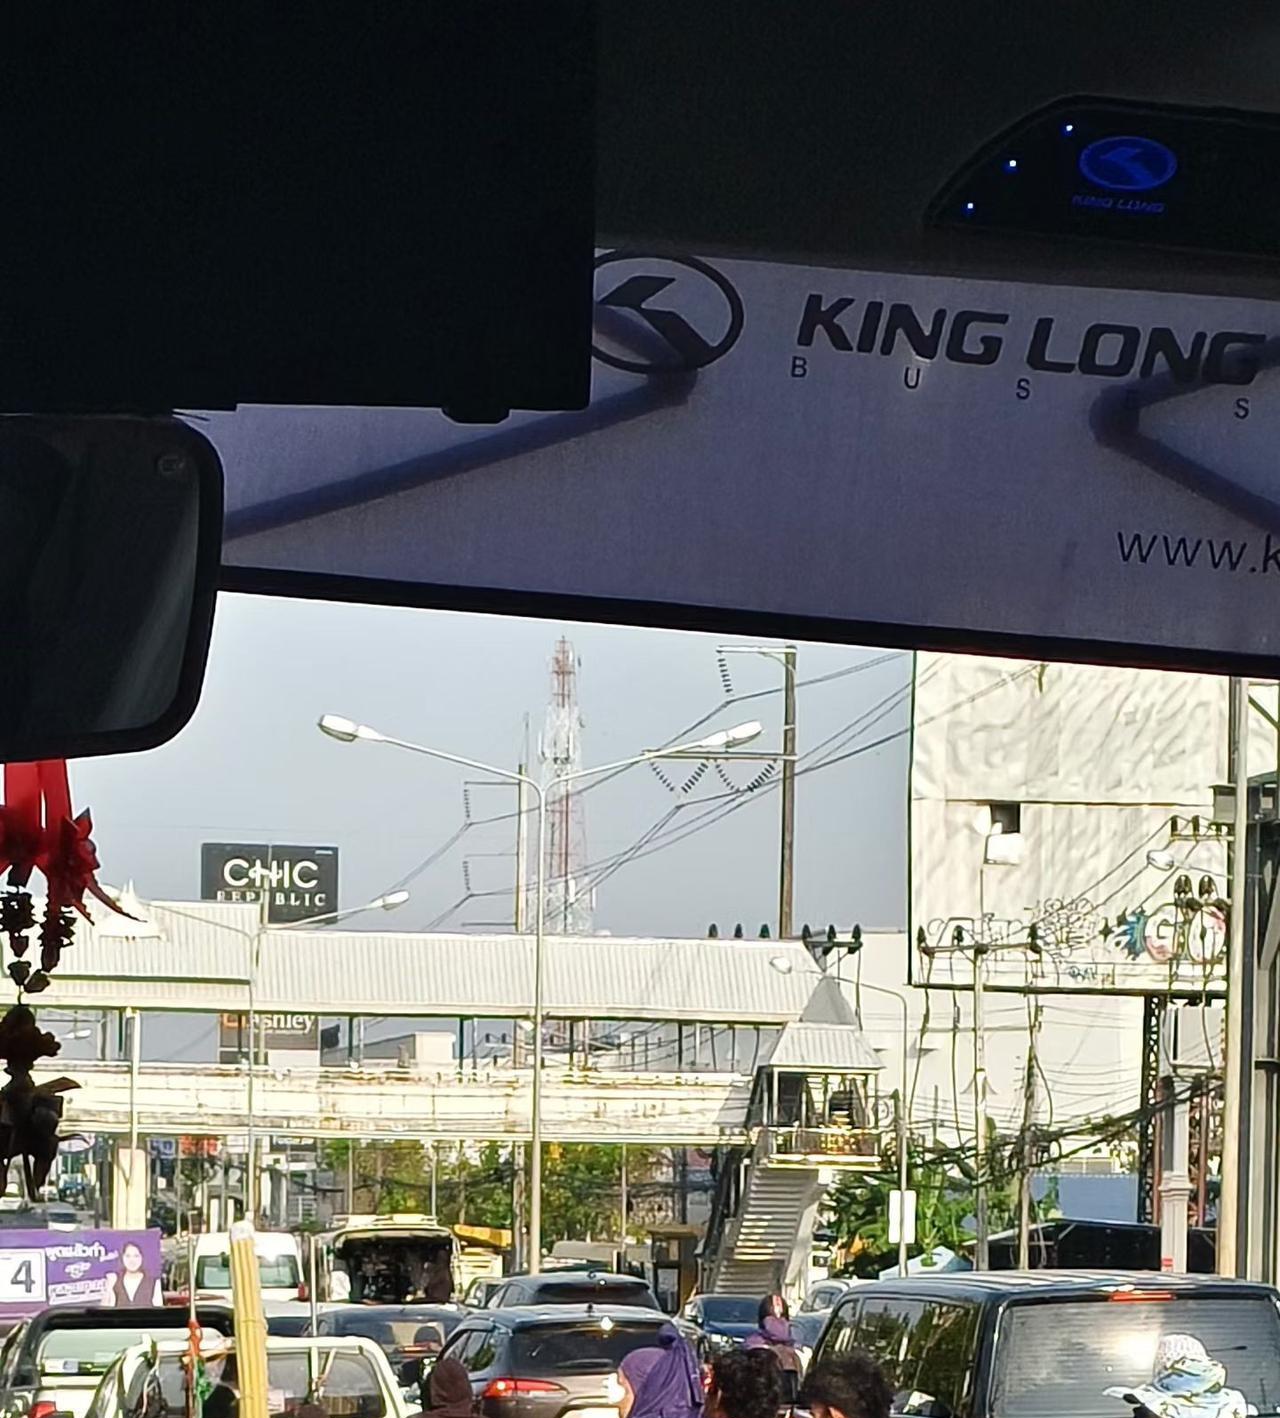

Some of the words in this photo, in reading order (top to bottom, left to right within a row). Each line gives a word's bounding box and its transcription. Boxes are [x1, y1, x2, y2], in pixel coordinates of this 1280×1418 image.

[797, 294, 1009, 365] KING
[1026, 317, 1266, 386] LONG
[223, 858, 319, 888] CHIC
[10, 1260, 36, 1293] 4
